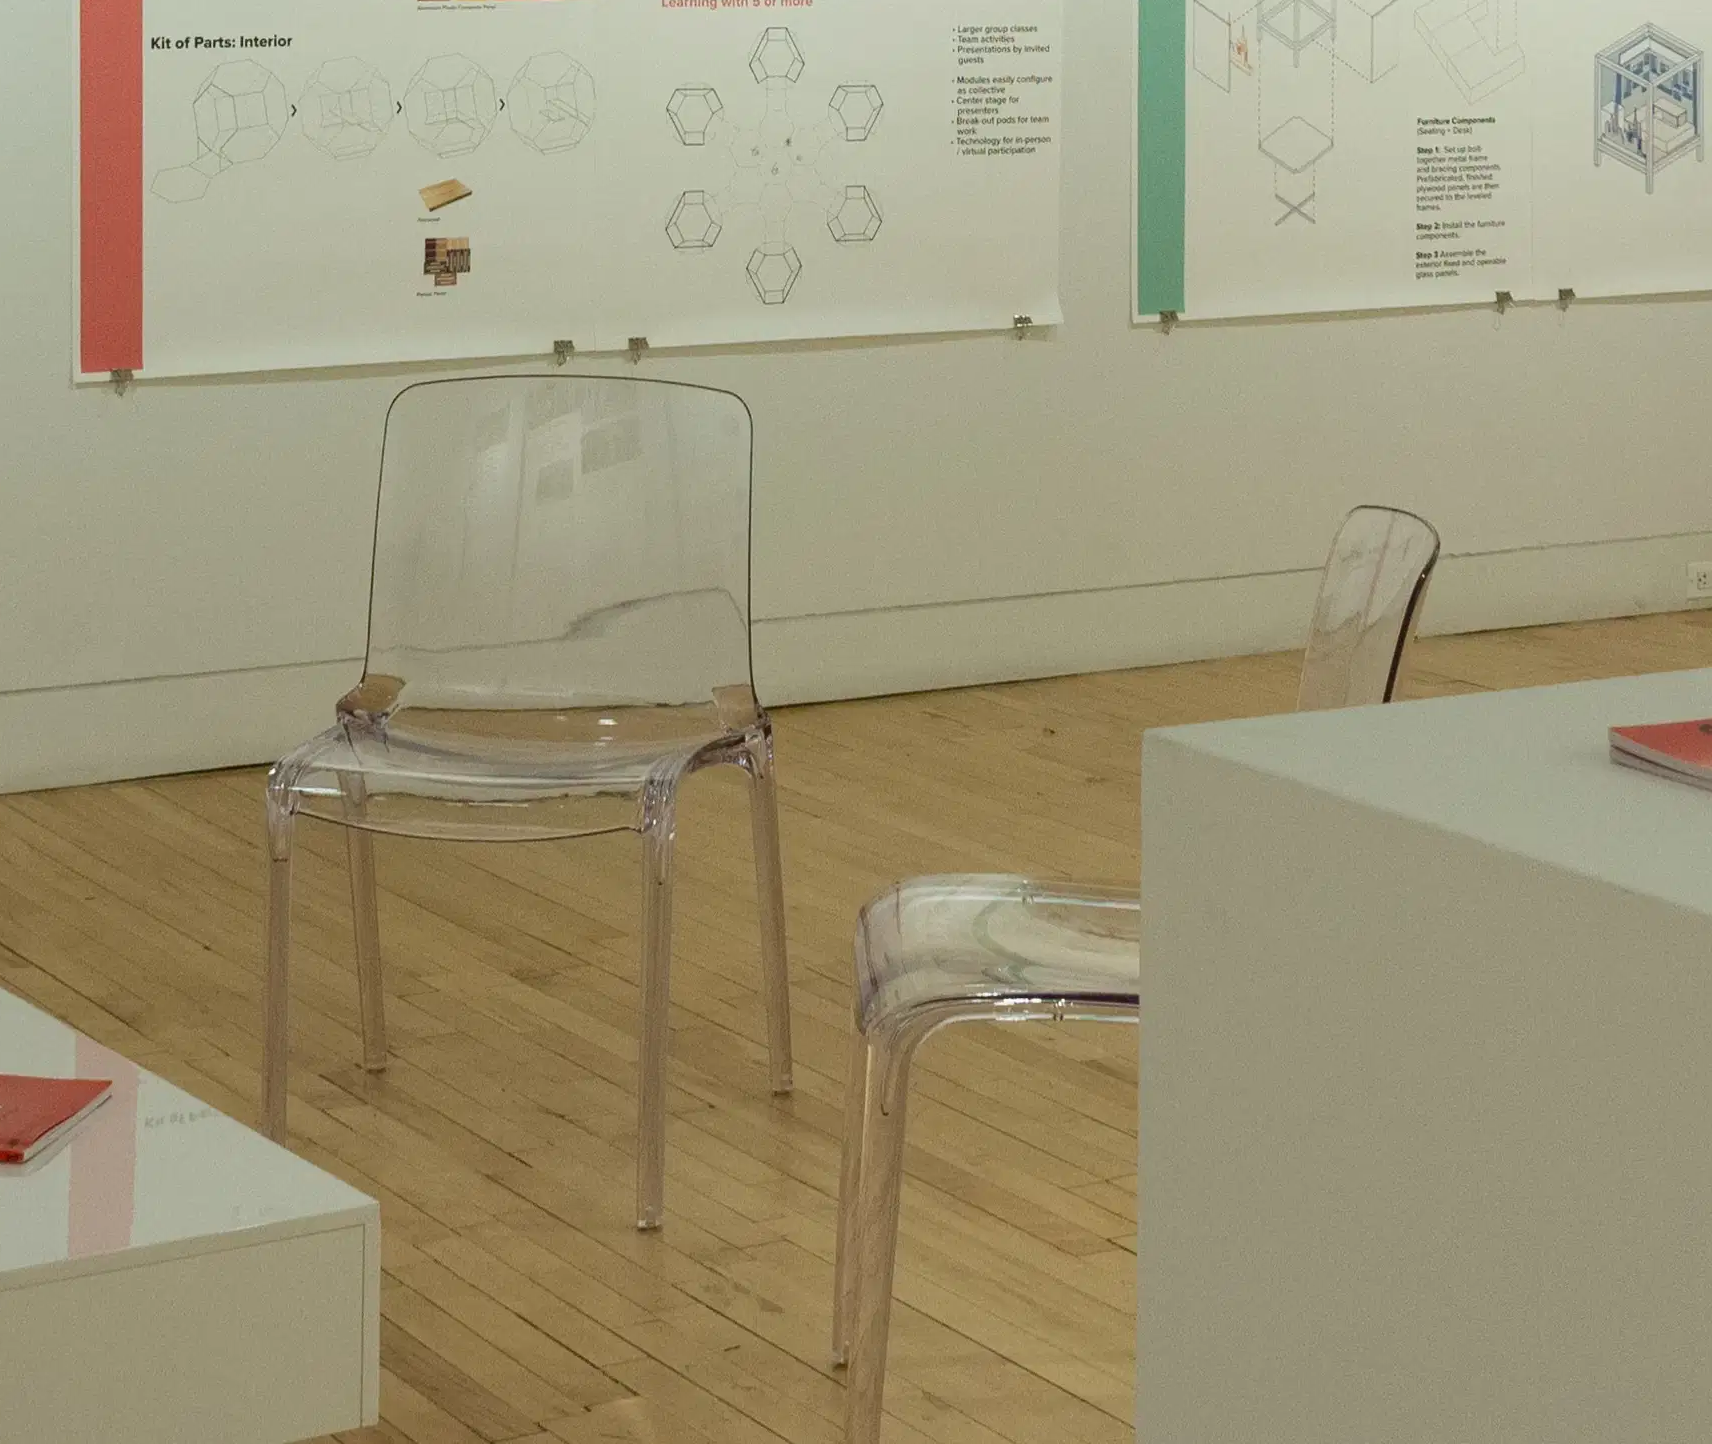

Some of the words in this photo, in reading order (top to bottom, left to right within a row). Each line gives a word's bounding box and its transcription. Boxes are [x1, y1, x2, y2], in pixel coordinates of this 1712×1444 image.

[151, 36, 171, 50] Kit
[175, 36, 191, 49] of
[194, 36, 236, 48] Parts:
[240, 34, 292, 48] Interior
